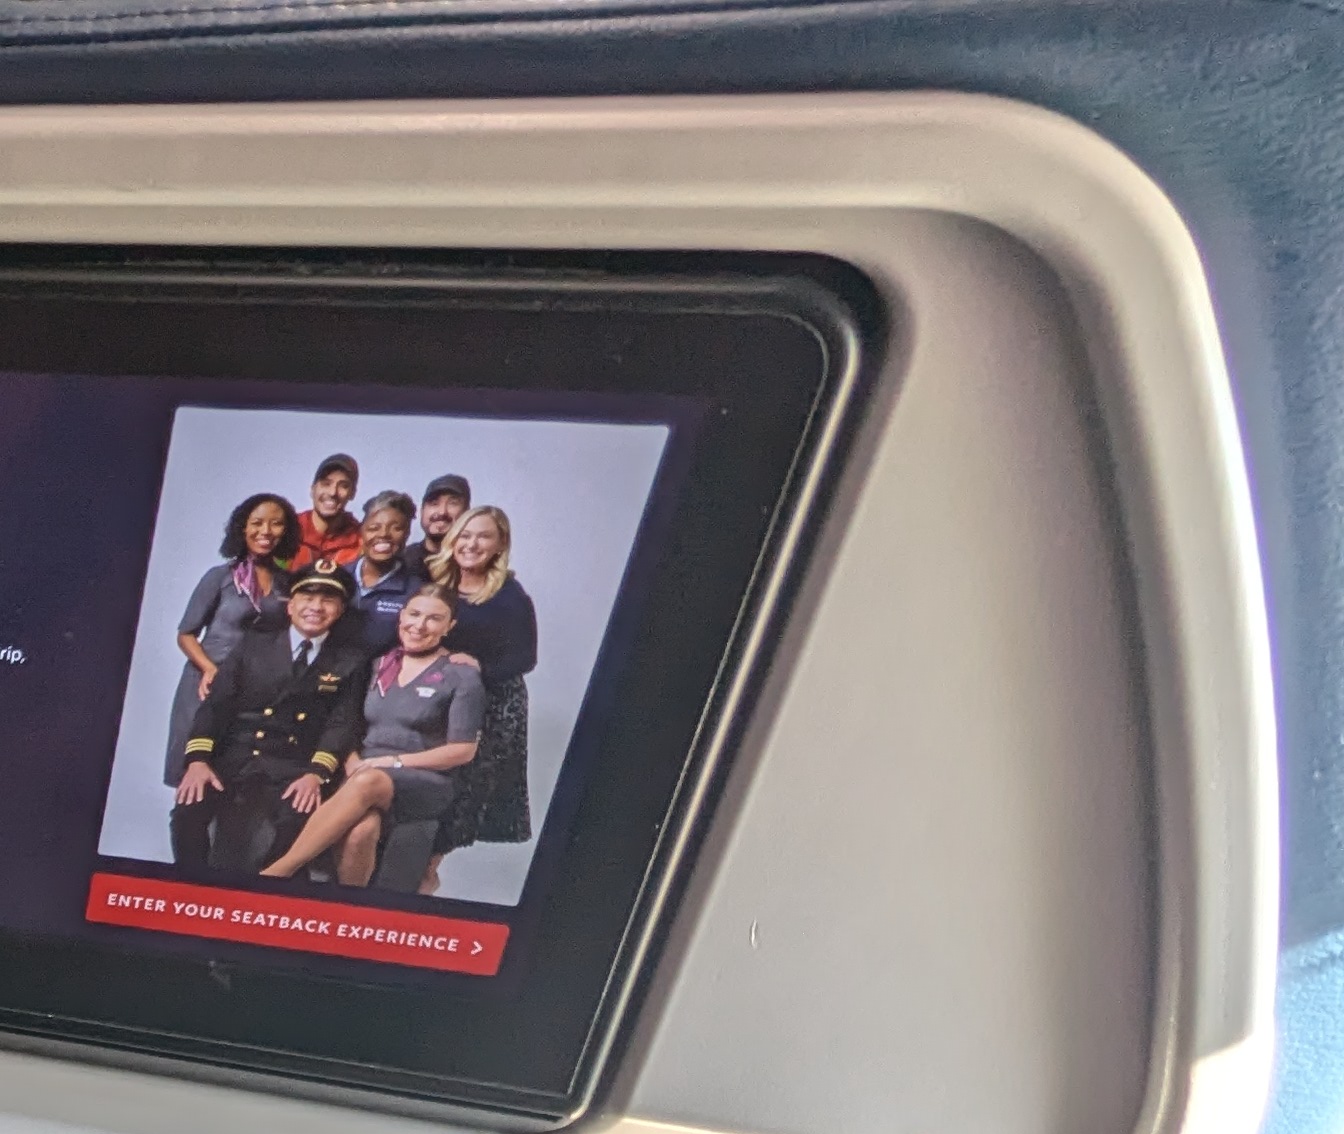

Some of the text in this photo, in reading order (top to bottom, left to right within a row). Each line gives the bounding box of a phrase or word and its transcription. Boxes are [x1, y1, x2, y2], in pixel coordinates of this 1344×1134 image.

[107, 893, 460, 952] ENTER YOUR SEATBACK EXPERIENCE
